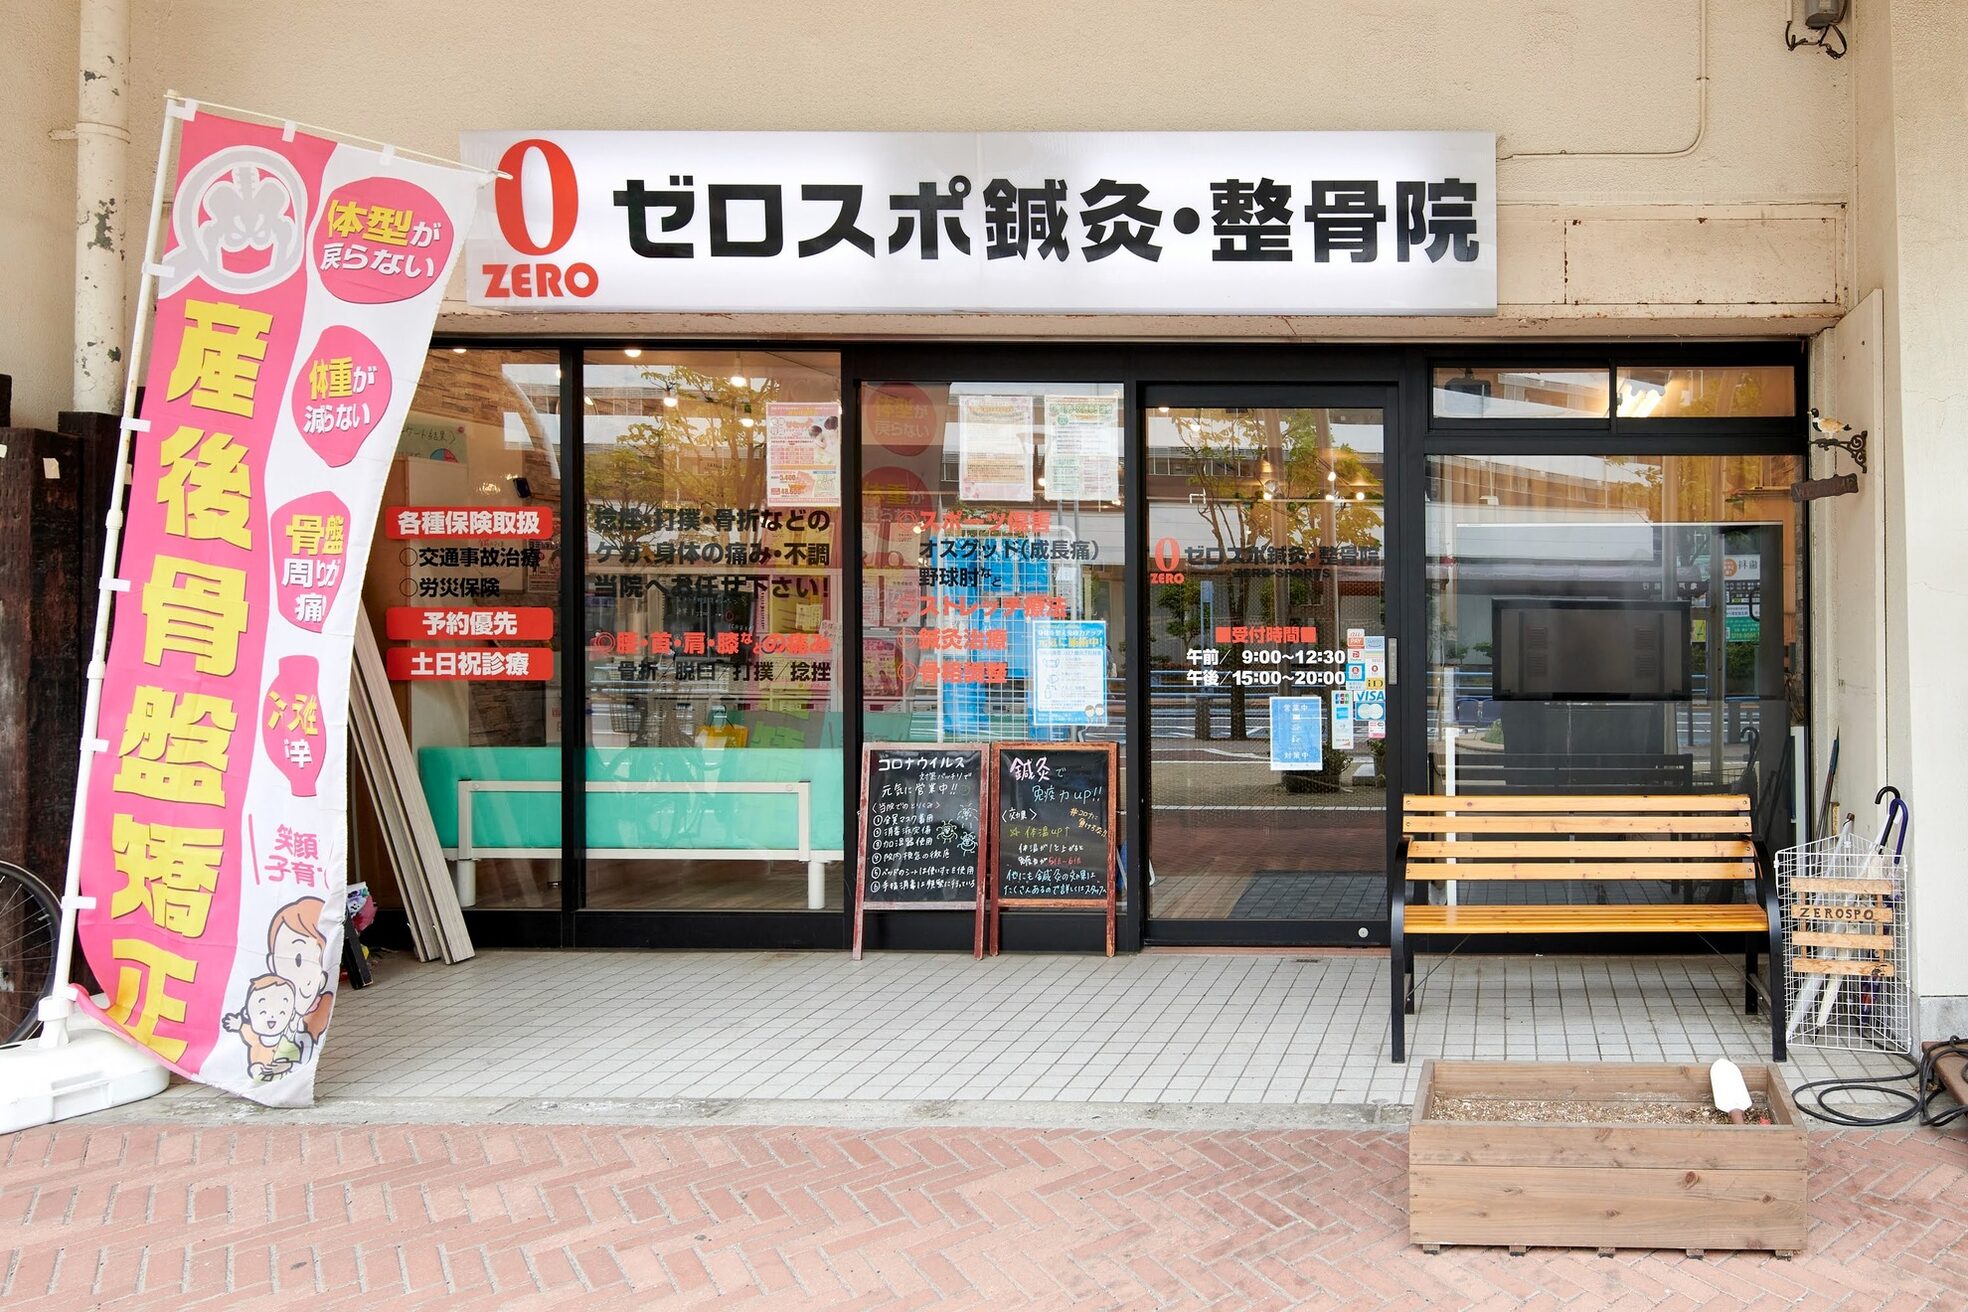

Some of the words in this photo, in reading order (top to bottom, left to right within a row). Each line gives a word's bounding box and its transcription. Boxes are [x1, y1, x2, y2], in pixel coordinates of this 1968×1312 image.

[327, 199, 442, 247] 体型が
[613, 175, 1480, 264] ゼロスポ鍼灸・整骨院
[320, 243, 435, 279] 戻らない
[482, 262, 599, 298] ZERO
[309, 357, 378, 401] 体重が
[303, 403, 371, 435] 減らない
[286, 514, 344, 555] 骨盤
[398, 511, 540, 535] 各種保険取扱
[282, 558, 341, 588] 周りが
[1150, 573, 1185, 585] ZERO
[422, 611, 518, 636] 予約優先
[411, 651, 529, 676] 土日祝診療
[108, 298, 274, 1065] 産後骨盤矯正
[1357, 690, 1385, 701] VISA
[878, 756, 965, 772] コロナウイルス
[1800, 907, 1874, 920] ZEROSPO
